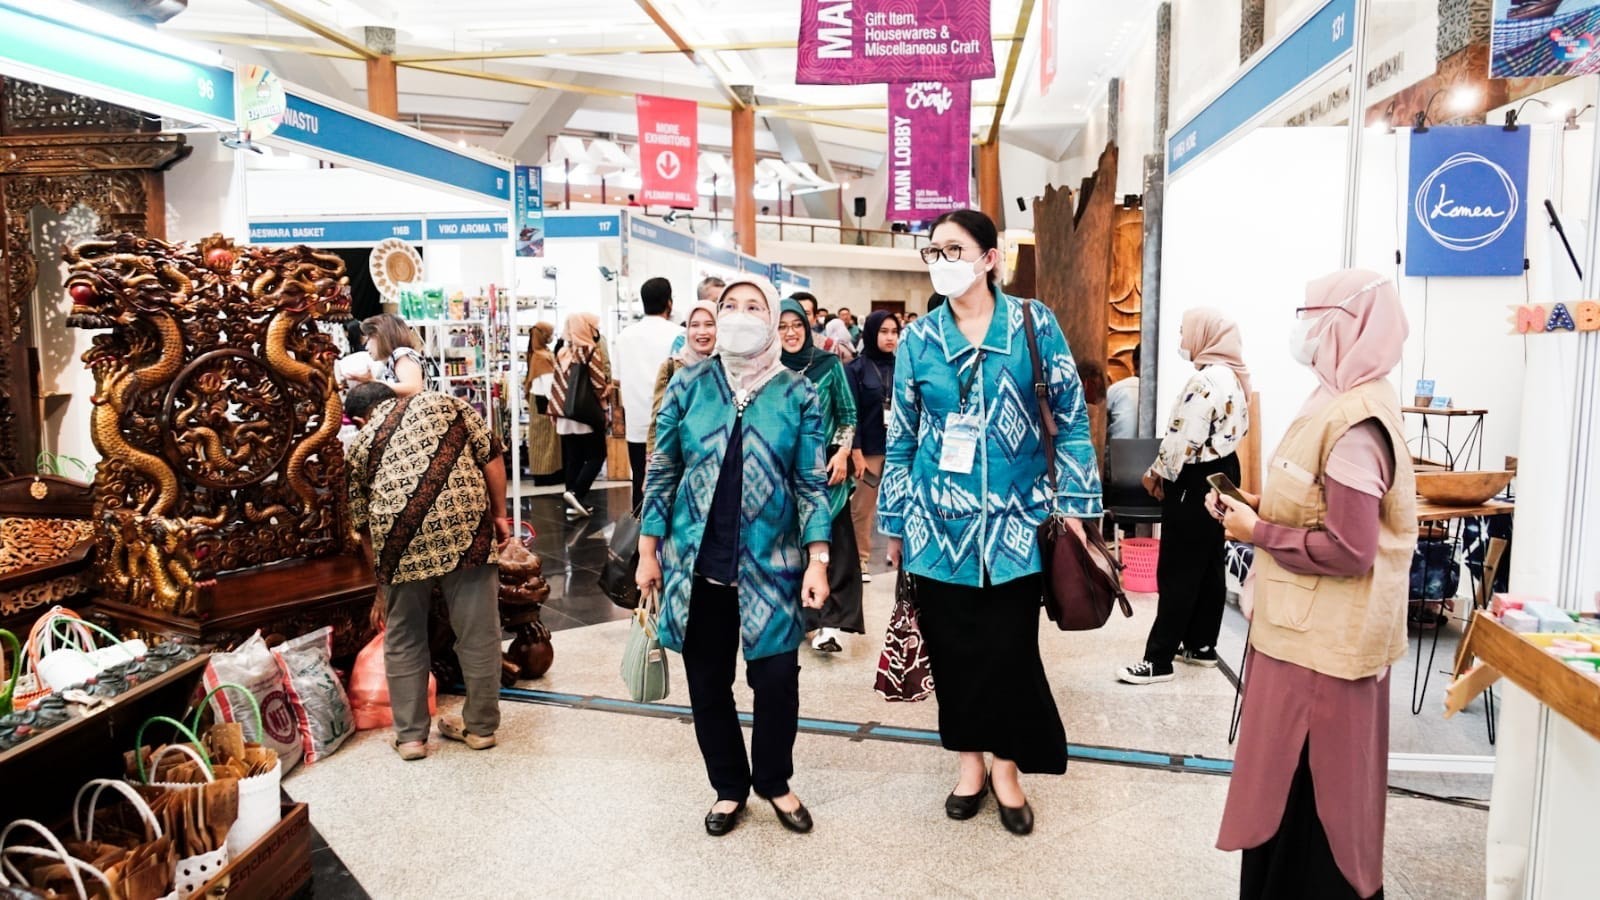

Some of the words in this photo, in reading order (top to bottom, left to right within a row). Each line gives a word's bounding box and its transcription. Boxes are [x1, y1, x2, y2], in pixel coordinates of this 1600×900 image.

[865, 13, 886, 27] Gift
[889, 13, 918, 26] Item,
[1332, 13, 1345, 43] 131
[817, 0, 852, 58] MA
[865, 27, 937, 41] Housewares
[940, 26, 950, 39] &
[865, 41, 948, 56] Miscellaneous
[950, 40, 980, 54] Craft
[197, 79, 215, 100] 96
[905, 87, 953, 115] Craft
[656, 122, 680, 134] MORE
[644, 132, 691, 148] EXHIBITORS
[894, 115, 911, 166] LOBBY
[894, 169, 911, 211] MAIN
[250, 227, 290, 239] AESWARA
[292, 227, 325, 238] BASKET
[438, 223, 458, 233] VIKO
[460, 222, 491, 233] AROMA
[599, 221, 611, 231] 117
